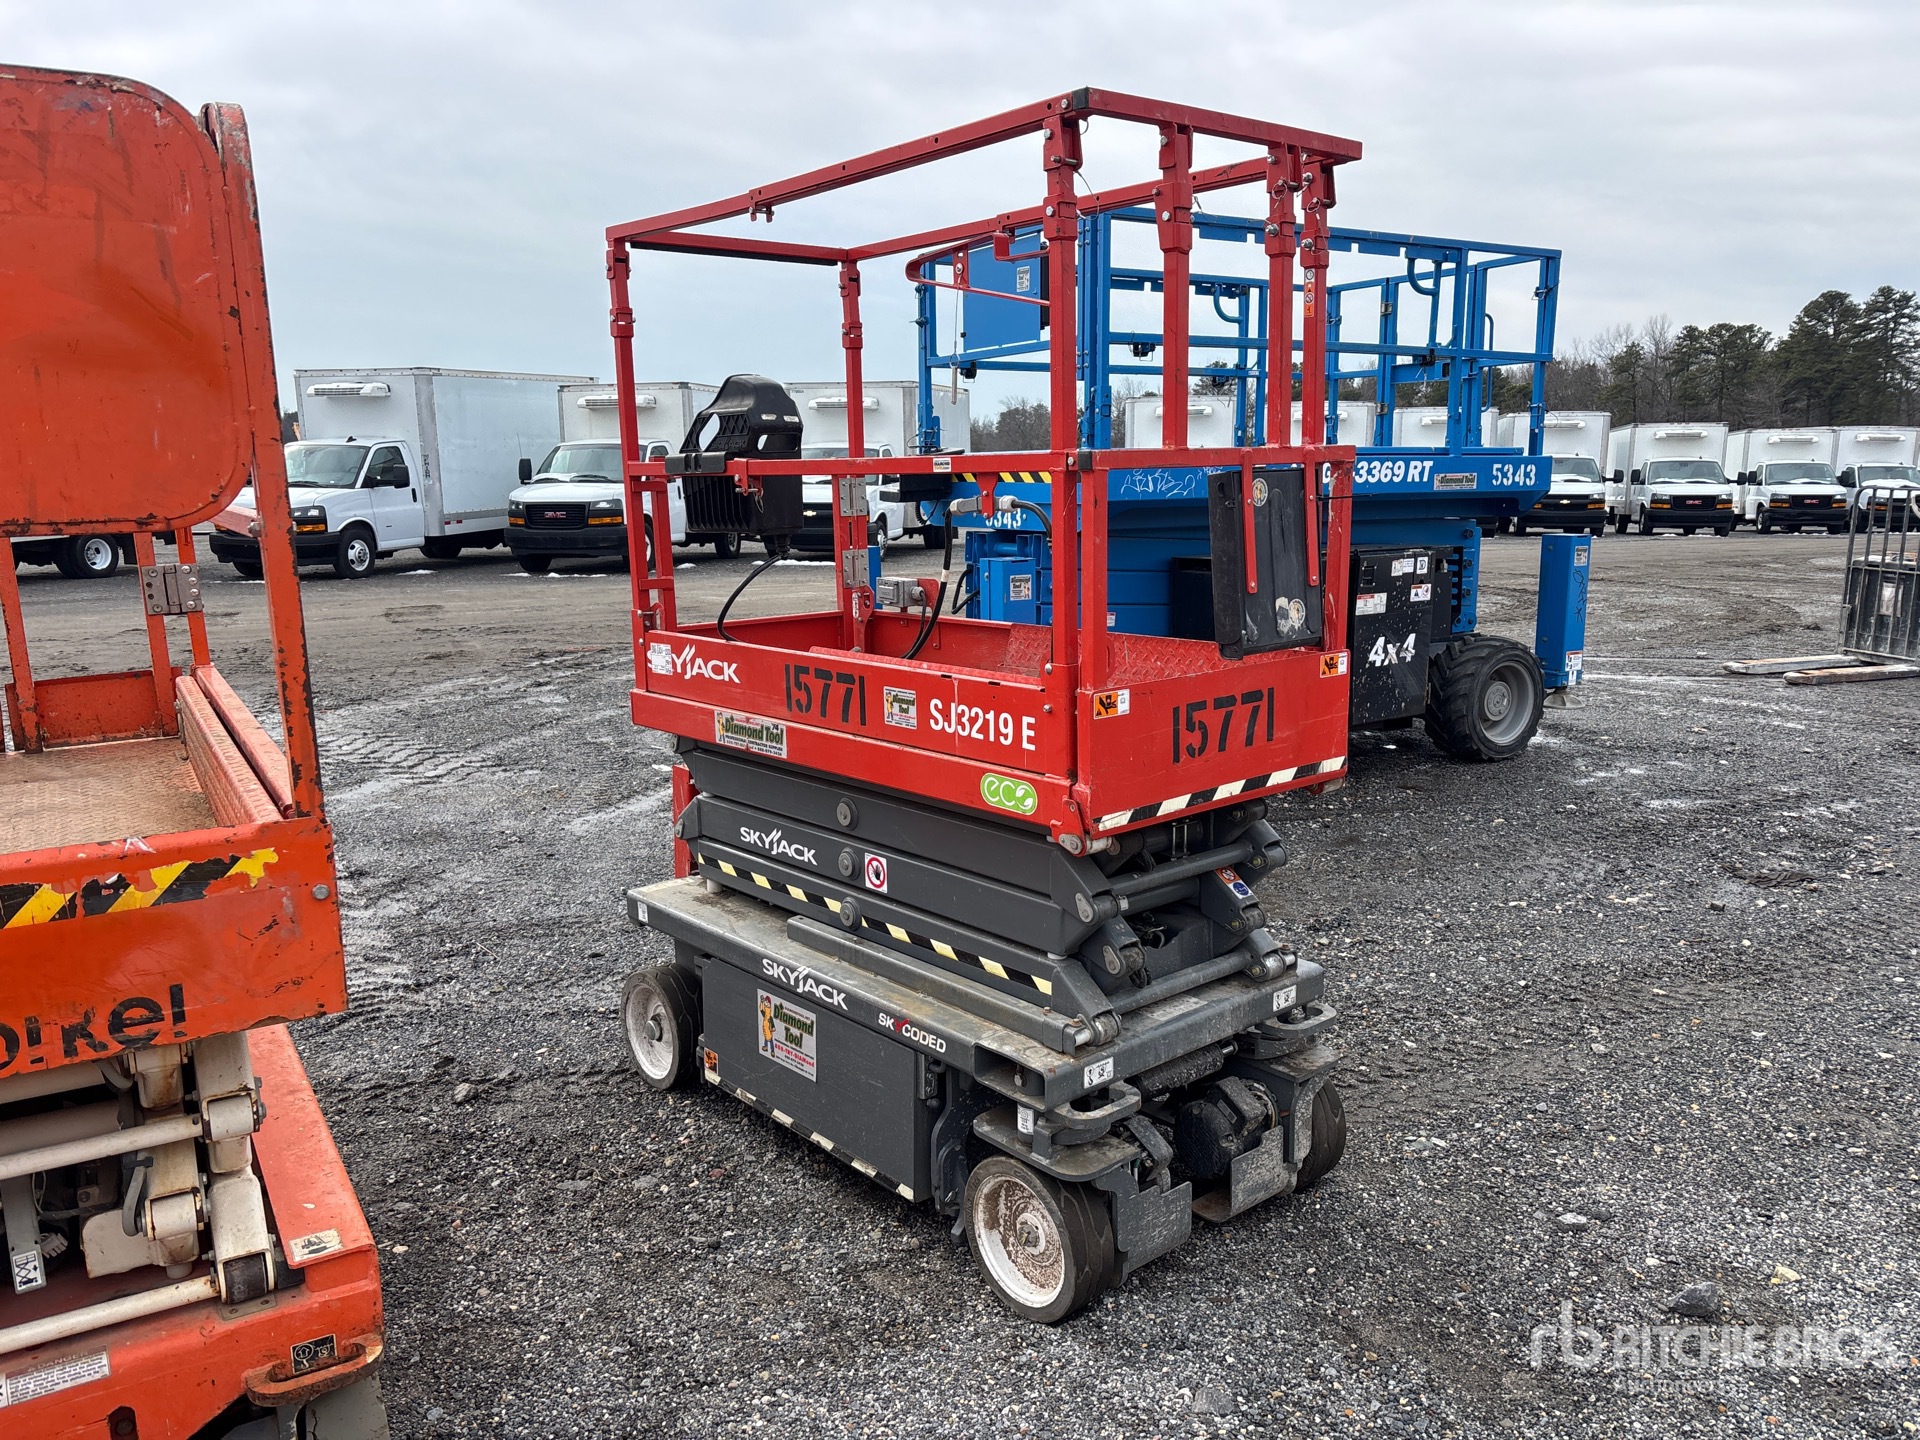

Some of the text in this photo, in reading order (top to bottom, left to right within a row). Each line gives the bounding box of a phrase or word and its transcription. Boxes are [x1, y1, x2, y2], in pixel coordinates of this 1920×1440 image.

[1322, 460, 1434, 484] G-3369 RT
[1492, 463, 1536, 486] 5343
[1368, 633, 1416, 667] 4x4
[784, 664, 867, 726] 15771
[724, 714, 764, 742] Diamond
[764, 725, 784, 746] Tool
[929, 698, 1036, 751] SJ3219 E
[1172, 687, 1275, 764] 15771
[984, 776, 1034, 811] eco
[740, 826, 818, 866] SKYJACK
[762, 958, 849, 1011] SKYJACK
[773, 1001, 815, 1038] Diamond
[784, 1025, 804, 1050] Tool
[878, 1012, 947, 1054] SKYCODED
